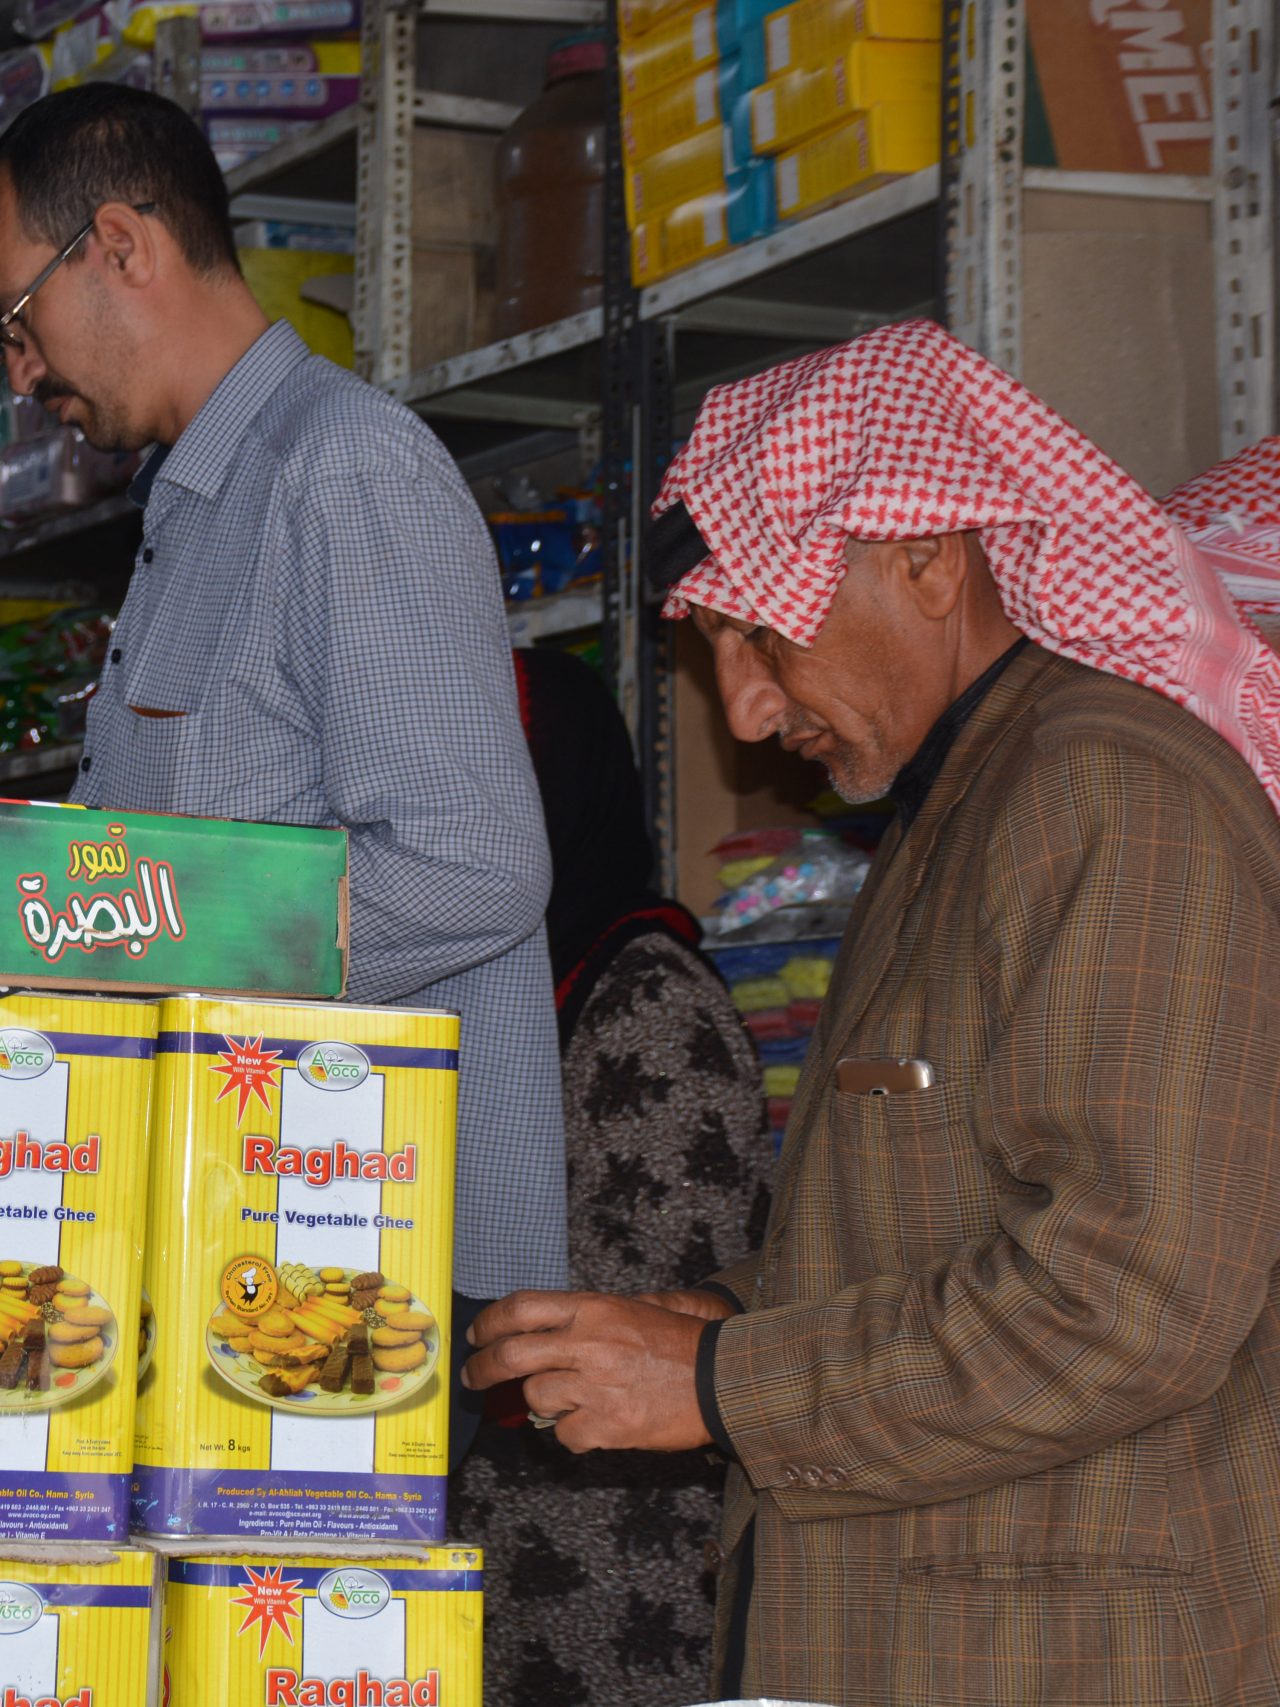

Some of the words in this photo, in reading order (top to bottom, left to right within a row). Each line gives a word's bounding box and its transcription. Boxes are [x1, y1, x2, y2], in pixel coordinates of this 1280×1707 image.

[1090, 0, 1213, 169] MEL
[70, 823, 127, 880] تمور
[18, 857, 187, 962] البصرة
[237, 1055, 262, 1066] New
[242, 1135, 417, 1187] Raghad
[53, 1206, 96, 1222] Ghee
[241, 1208, 280, 1224] Pure
[285, 1210, 368, 1228] Vegetable
[373, 1214, 414, 1230] Ghee
[199, 1443, 214, 1452] Net
[228, 1439, 236, 1452] 8
[237, 1444, 251, 1453] kgs
[16, 1489, 27, 1498] Oil
[46, 1489, 69, 1499] Hama
[75, 1490, 95, 1501] Syria
[217, 1487, 255, 1496] Produced
[269, 1488, 303, 1497] Al-Ahliah
[305, 1489, 344, 1499] Vegetable
[345, 1490, 357, 1499] Oil
[375, 1491, 398, 1500] Hama
[402, 1492, 422, 1503] Syria
[28, 1520, 69, 1530] Antioxidants
[238, 1519, 275, 1529] Ingredients
[279, 1520, 294, 1528] Pure
[295, 1520, 312, 1528] Palm
[312, 1520, 322, 1529] Oil
[327, 1520, 355, 1530] Flavours
[359, 1521, 399, 1531] Antioxidants
[15, 1531, 40, 1539] Vitamin
[257, 1585, 282, 1596] New
[266, 1667, 439, 1707] Raghad
